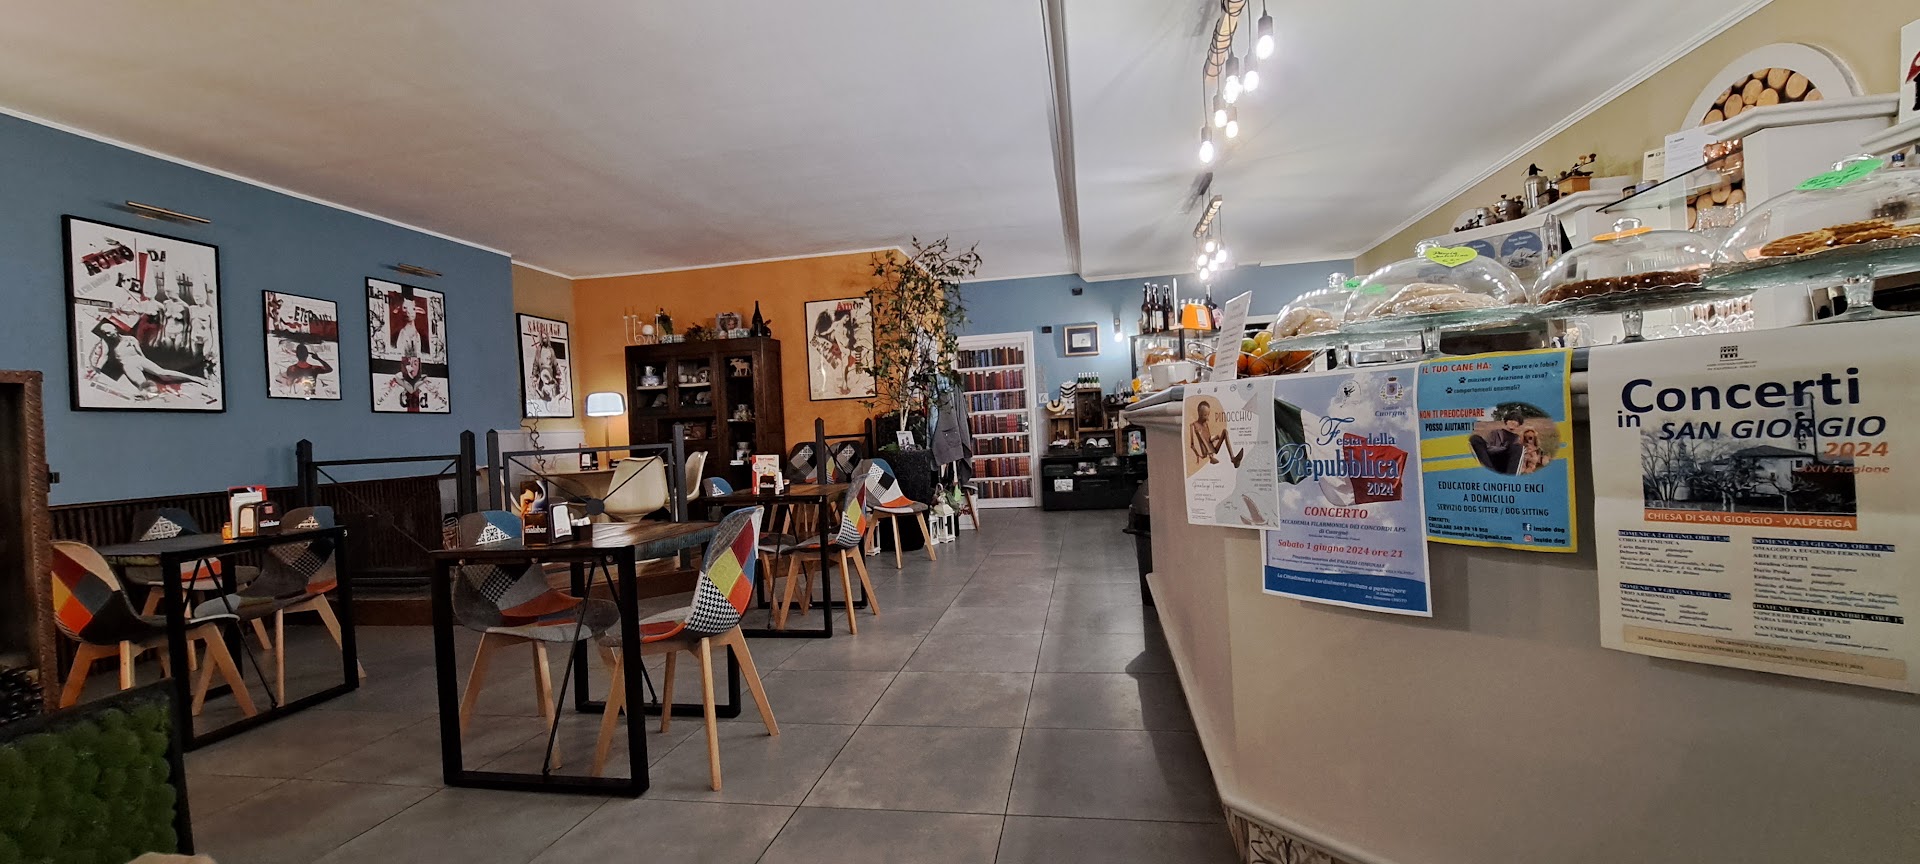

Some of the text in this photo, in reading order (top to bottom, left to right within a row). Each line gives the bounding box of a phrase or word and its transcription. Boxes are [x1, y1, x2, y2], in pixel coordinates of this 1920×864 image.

[836, 301, 863, 311] Amor
[1422, 362, 1492, 374] IL TUO CANE HA:
[1511, 364, 1527, 372] paure
[1539, 360, 1559, 368] fobie?
[1621, 367, 1860, 413] Concerti
[1215, 410, 1252, 423] PINOCCHIO
[1420, 408, 1485, 418] NON TI PREOCCUPARE
[1316, 415, 1396, 446] Festa della
[1425, 423, 1443, 432] POSSO
[1444, 422, 1471, 431] AIUTARTI
[1617, 410, 1887, 440] in SAN GIORGIO
[1823, 441, 1889, 458] 2024
[1277, 442, 1399, 481] Repubblica
[1367, 482, 1394, 496] 2024
[1438, 481, 1544, 493] EDUCATORE CINOFILO ENCI
[1463, 493, 1515, 504] A DOMICILIO
[1304, 506, 1368, 519] CONCERTO
[1437, 503, 1462, 512] SERVIZIO
[1463, 505, 1477, 513] DOG
[1478, 505, 1499, 514] SITTER
[1505, 507, 1521, 515] DOG
[1522, 508, 1549, 516] SITTING
[1647, 512, 1682, 520] CHIESA
[1699, 514, 1721, 523] SAN
[1723, 515, 1773, 524] GIORGIO
[1784, 517, 1853, 528] VALPERGA
[525, 525, 547, 533] malabar
[1278, 539, 1304, 549] Sabato
[1313, 543, 1344, 553] giugno
[1347, 545, 1369, 555] 2024
[1371, 548, 1389, 557] ore
[1391, 549, 1403, 558] 21
[1315, 579, 1347, 587] cordialmente
[1373, 586, 1406, 594] partecipare
